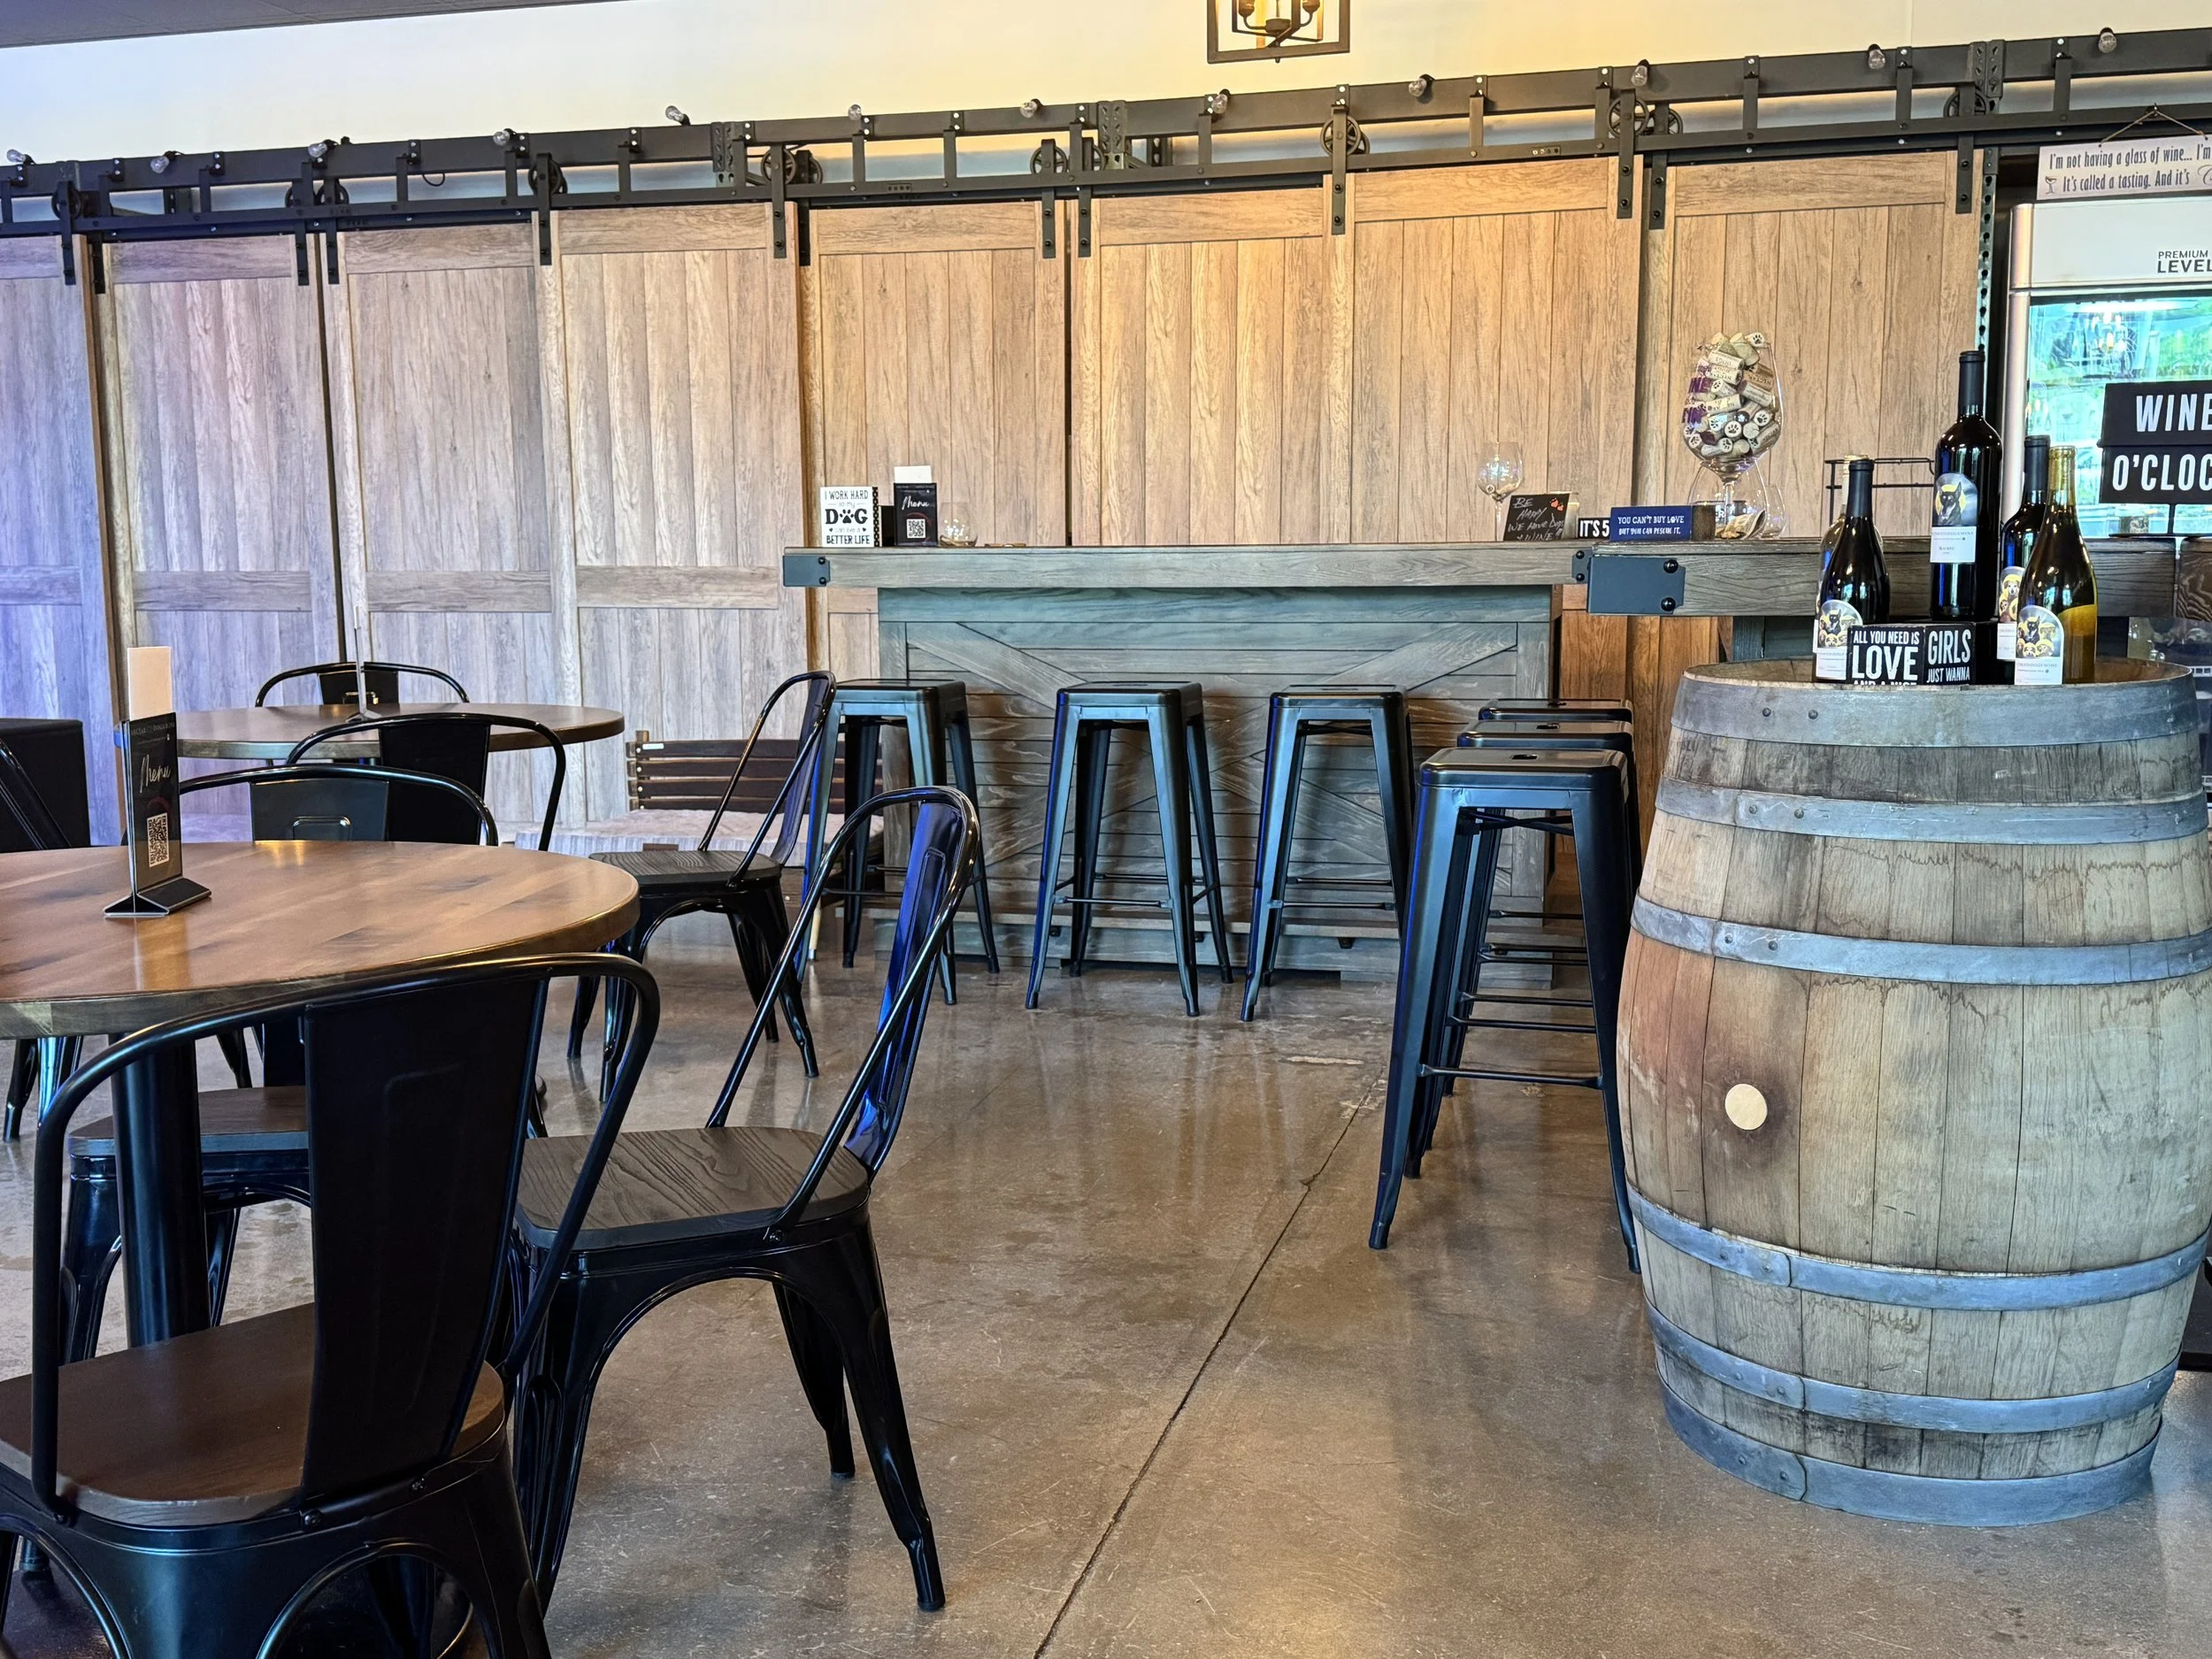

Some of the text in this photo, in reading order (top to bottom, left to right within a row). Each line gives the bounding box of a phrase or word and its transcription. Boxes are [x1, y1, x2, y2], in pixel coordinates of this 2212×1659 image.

[2049, 143, 2211, 169] I'm not having a glass of wine... I'm
[2062, 176, 2078, 192] It's
[2079, 173, 2106, 190] called
[2108, 176, 2115, 188] a
[2118, 171, 2152, 189] tasting.
[2154, 170, 2172, 187] And
[2175, 168, 2191, 185] it's
[2158, 250, 2208, 259] PREMIUM
[2136, 393, 2212, 433] WINE
[824, 489, 869, 501] I WORK HARD
[901, 495, 930, 510] Menu
[1513, 497, 1534, 509] BE
[1617, 514, 1685, 525] YOU CAN'T BUY LOVE
[1508, 522, 1526, 533] WE
[1579, 519, 1610, 537] IT'S 5
[1653, 526, 1672, 535] RESCUE
[826, 534, 871, 544] BETTER LIFE
[1853, 630, 1920, 645] ALL YOU NEED IS
[1927, 629, 1972, 665] GIRLS
[1851, 645, 1919, 681] LOVE
[1926, 666, 1970, 683] JUST WANNA
[140, 754, 172, 794] Menu
